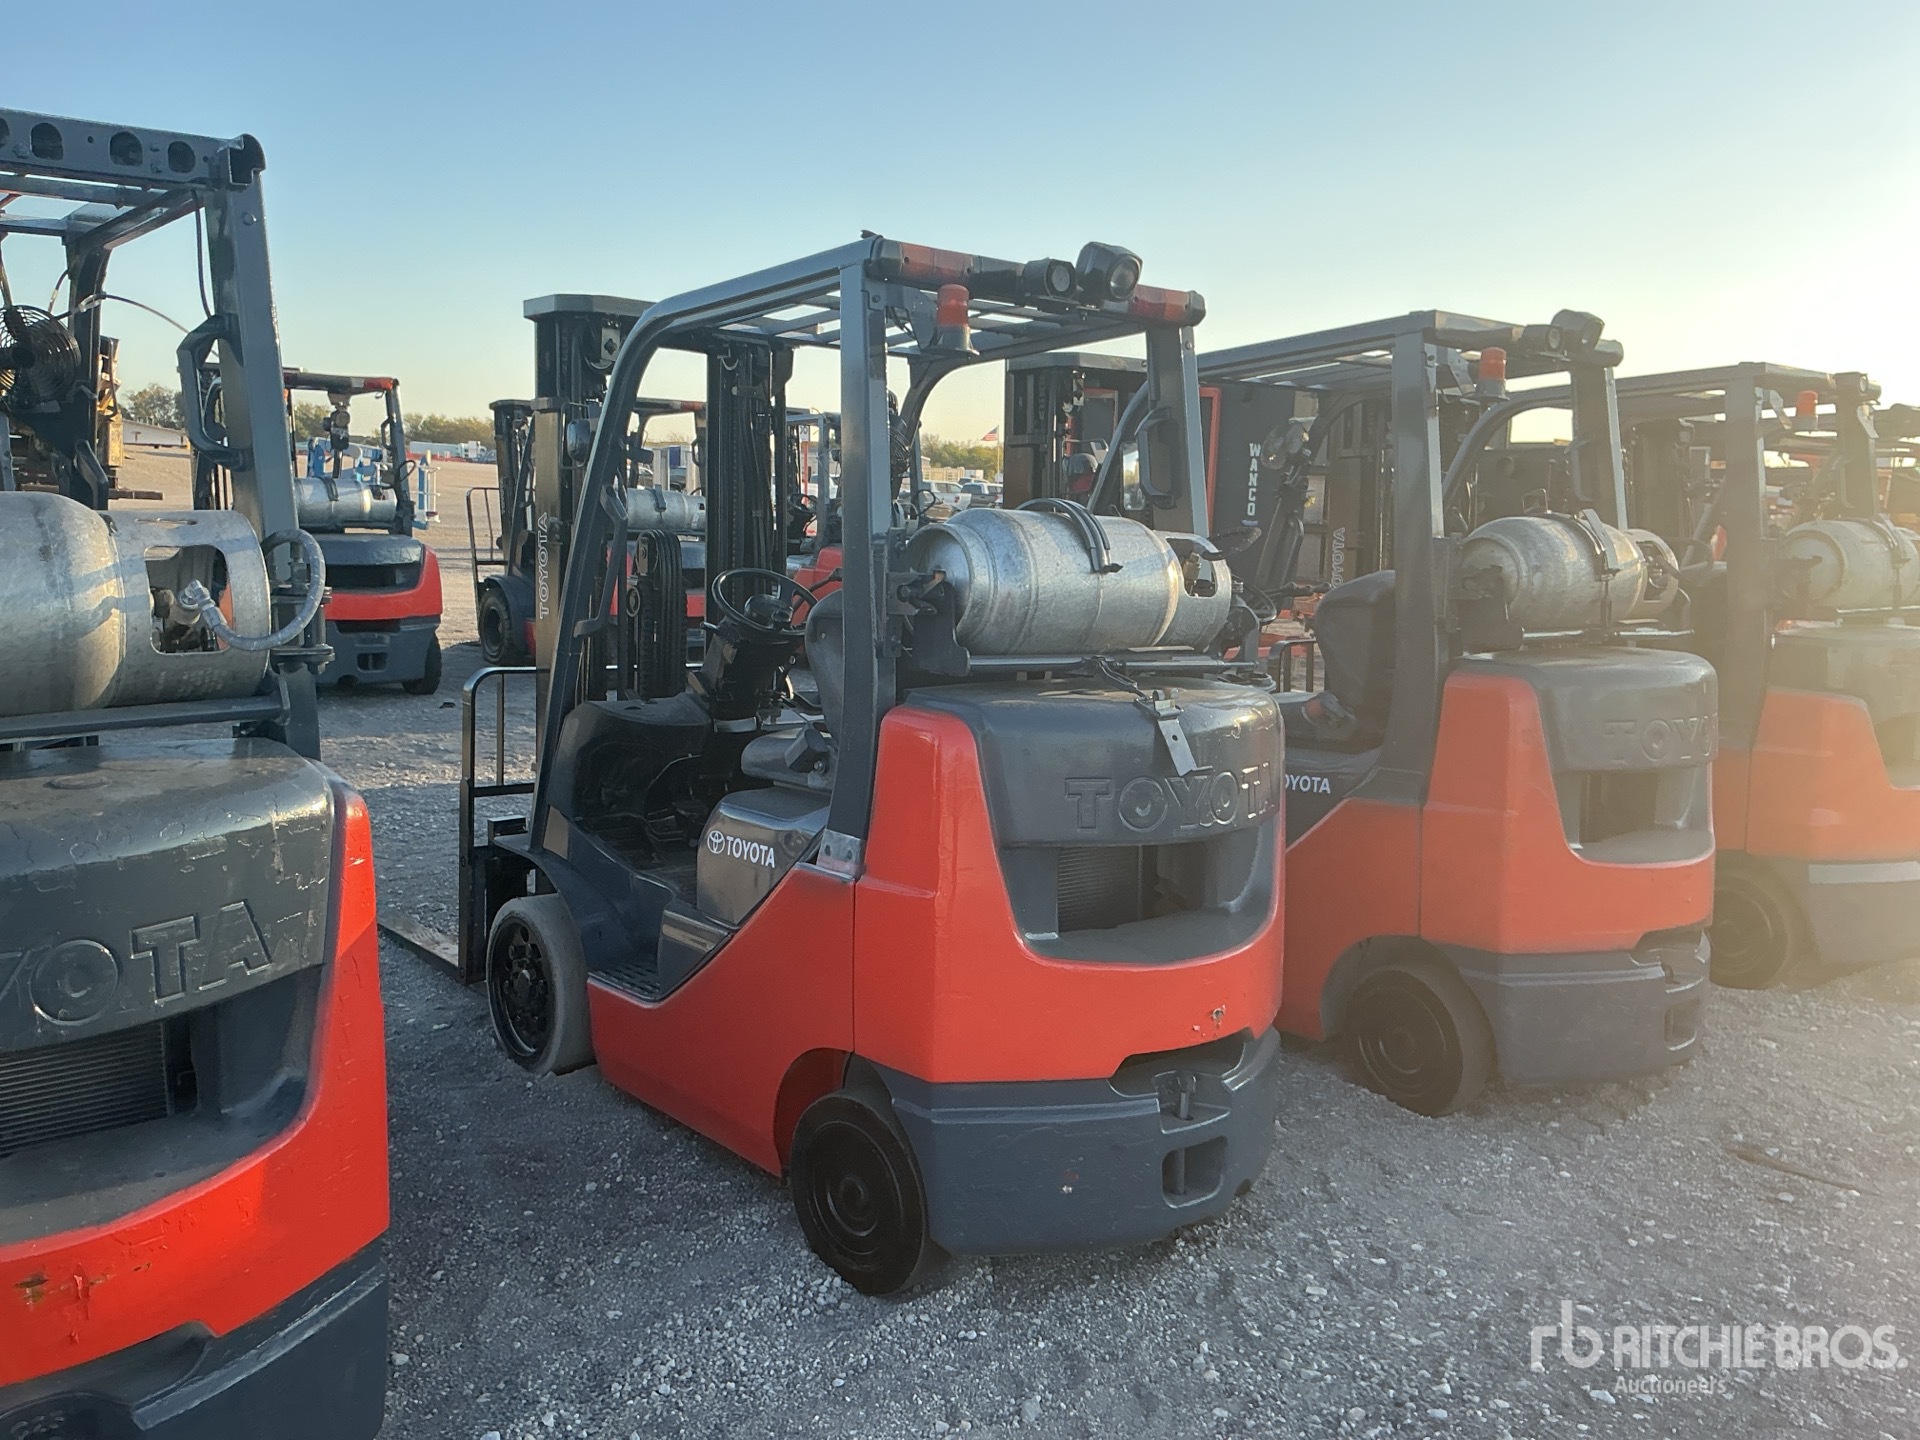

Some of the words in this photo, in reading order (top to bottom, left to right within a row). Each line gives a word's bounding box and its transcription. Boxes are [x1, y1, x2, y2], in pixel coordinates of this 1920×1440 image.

[1247, 443, 1261, 516] WANCO
[537, 512, 550, 619] TOYOTA
[1331, 527, 1346, 589] OYOTA
[1284, 773, 1331, 794] YOTA
[726, 835, 776, 868] TOYOTA
